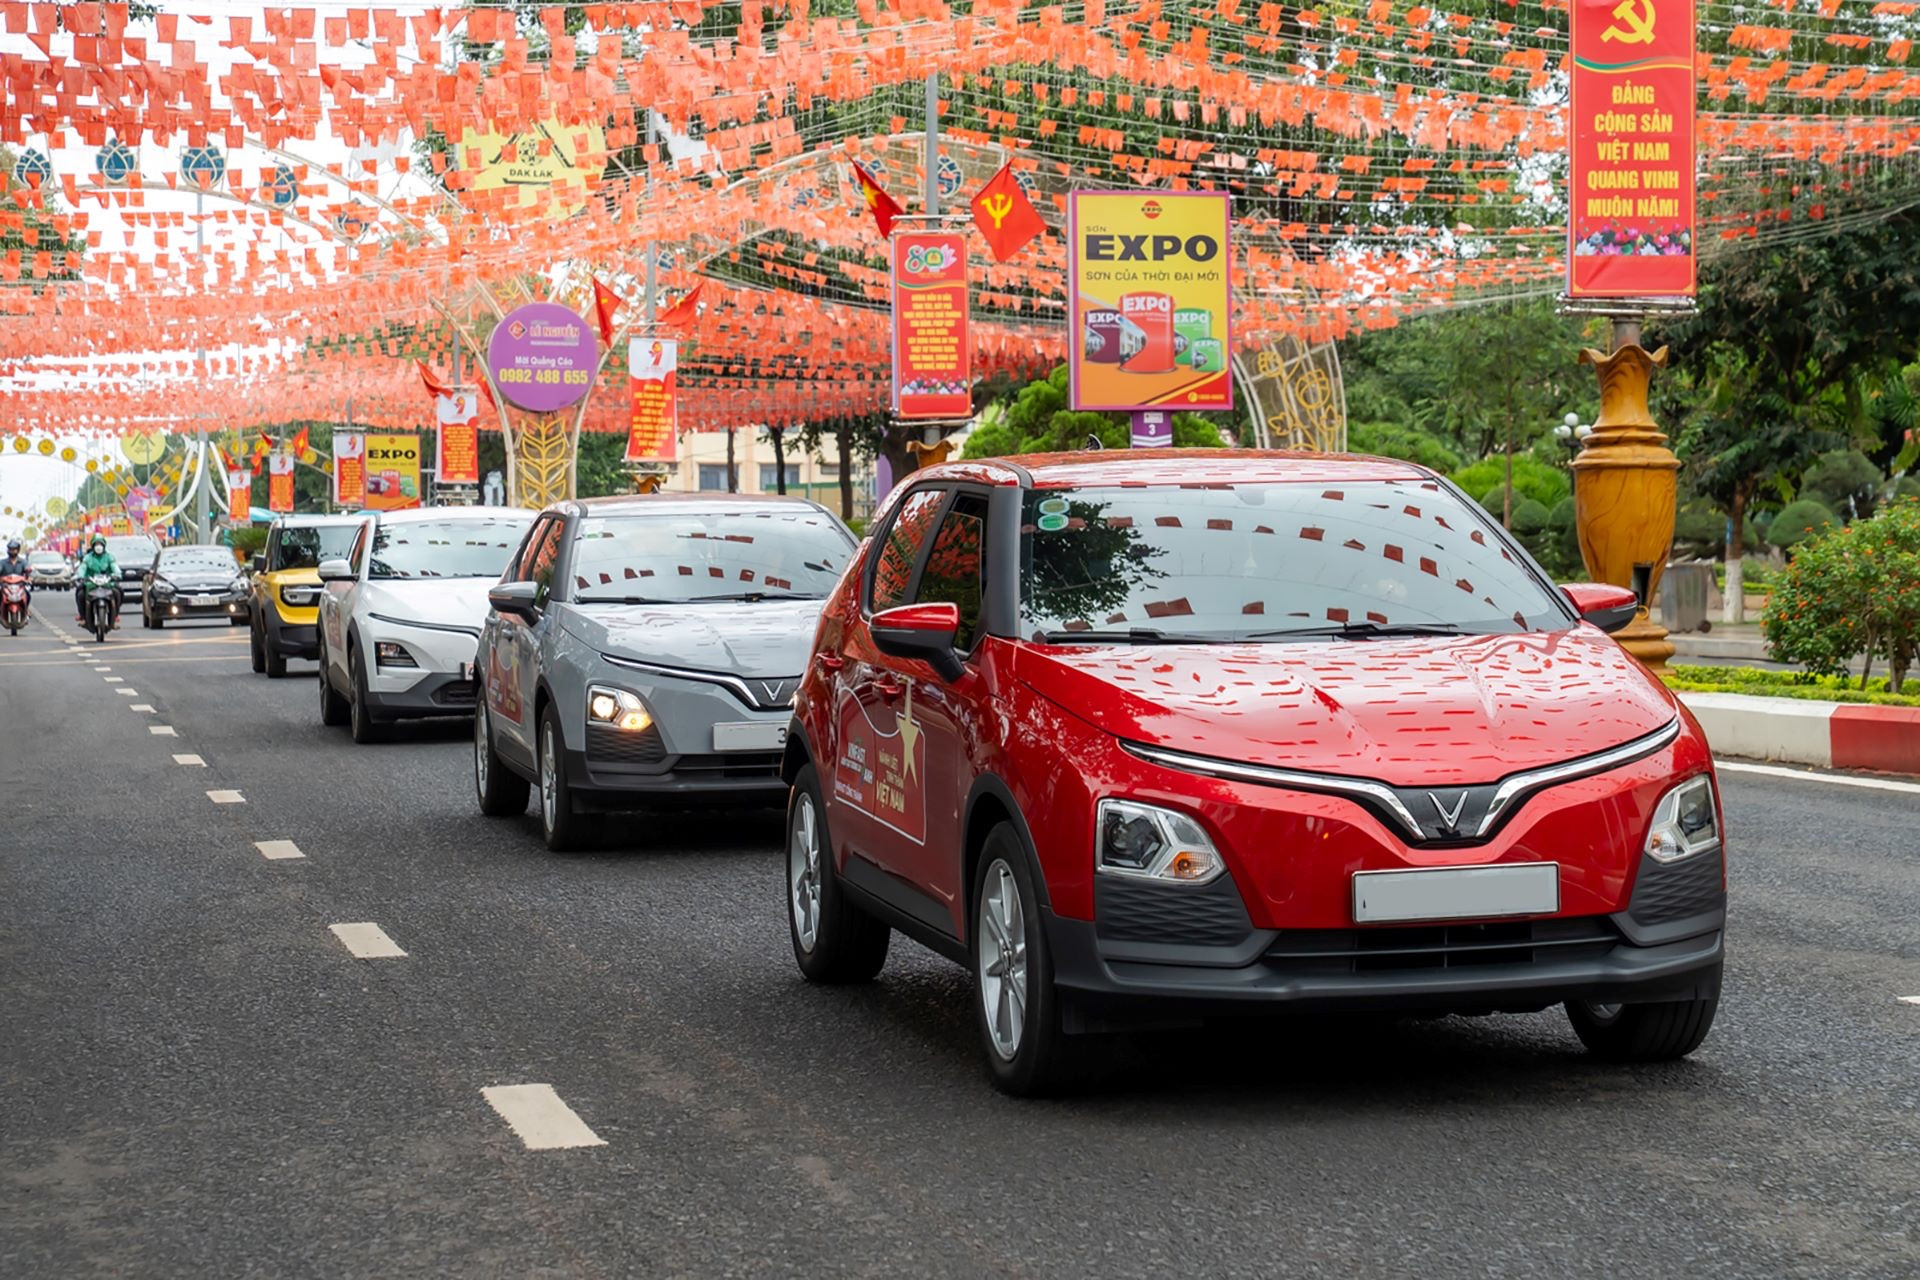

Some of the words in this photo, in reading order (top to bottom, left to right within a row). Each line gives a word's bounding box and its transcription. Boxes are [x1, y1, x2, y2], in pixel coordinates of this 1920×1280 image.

[1611, 80, 1654, 104] ĐẢNG
[1594, 110, 1636, 136] CỘNG
[1640, 108, 1673, 132] SẢN
[1597, 139, 1630, 164] VIỆT
[1633, 142, 1669, 161] NAM
[1587, 170, 1639, 191] QUANG
[1643, 170, 1679, 189] VINH
[1587, 195, 1633, 217] MUÔN
[1637, 195, 1679, 217] NĂM!
[1085, 234, 1218, 262] EXPO
[1086, 271, 1111, 281] SƠN
[1115, 269, 1138, 281] CỦA
[1142, 270, 1170, 281] THỜI
[1174, 271, 1193, 283] ĐẠI
[1197, 269, 1219, 281] MỚI
[1123, 296, 1171, 312] EXPO
[499, 368, 532, 383] 0982
[535, 369, 560, 384] 488
[563, 370, 588, 384] 655
[1148, 424, 1156, 436] 3
[368, 449, 416, 460] EXPO
